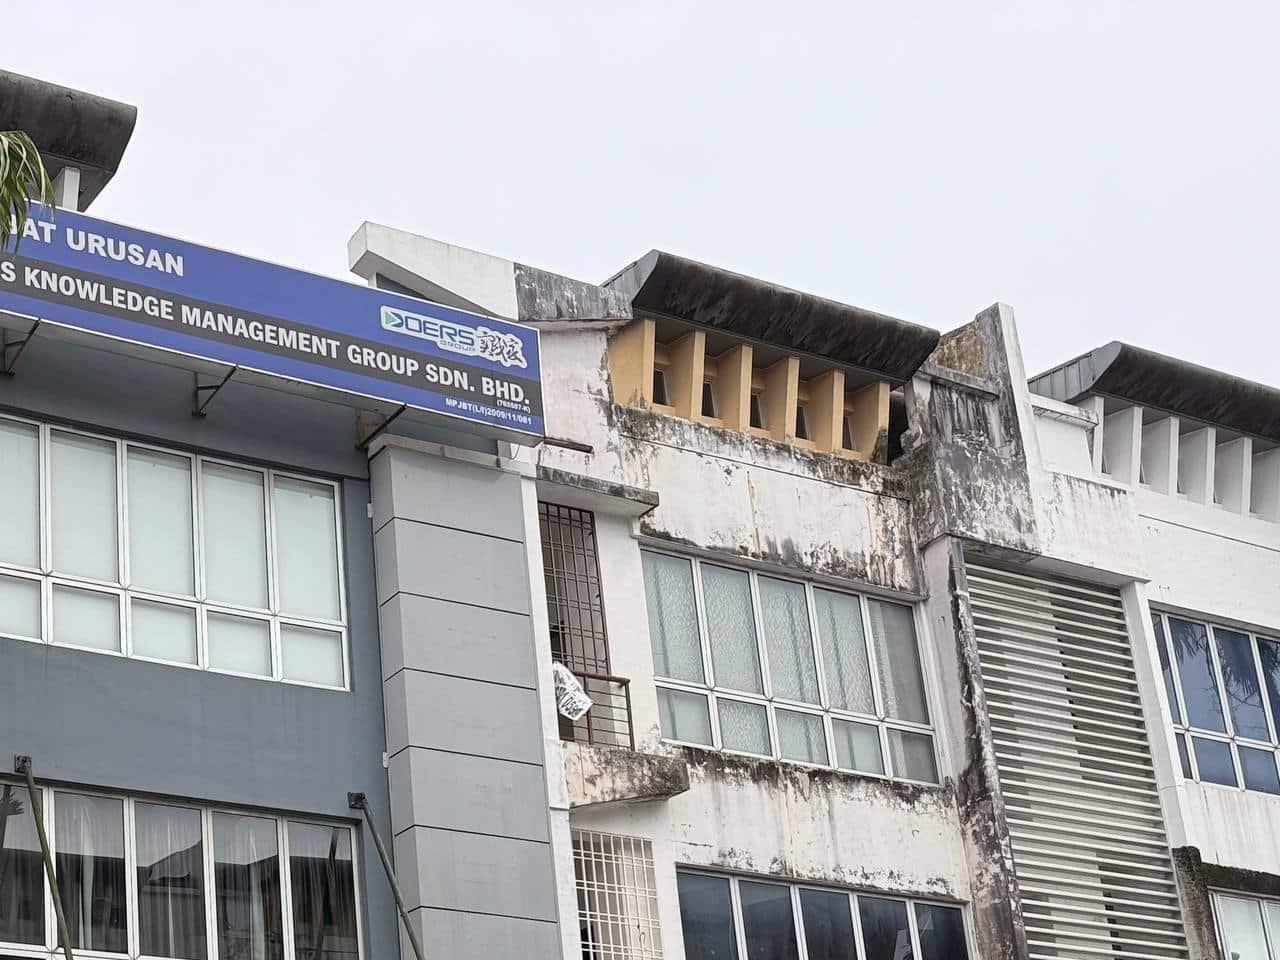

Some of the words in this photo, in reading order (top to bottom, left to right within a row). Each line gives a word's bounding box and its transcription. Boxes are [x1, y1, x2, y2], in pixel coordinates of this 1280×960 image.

[66, 227, 184, 277] URUSAN
[24, 266, 174, 320] KNOWLEDGE
[181, 304, 341, 360] MANAGEMENT
[347, 344, 420, 377] GROUP
[425, 363, 475, 392] SDN.
[481, 376, 530, 404] BHD.
